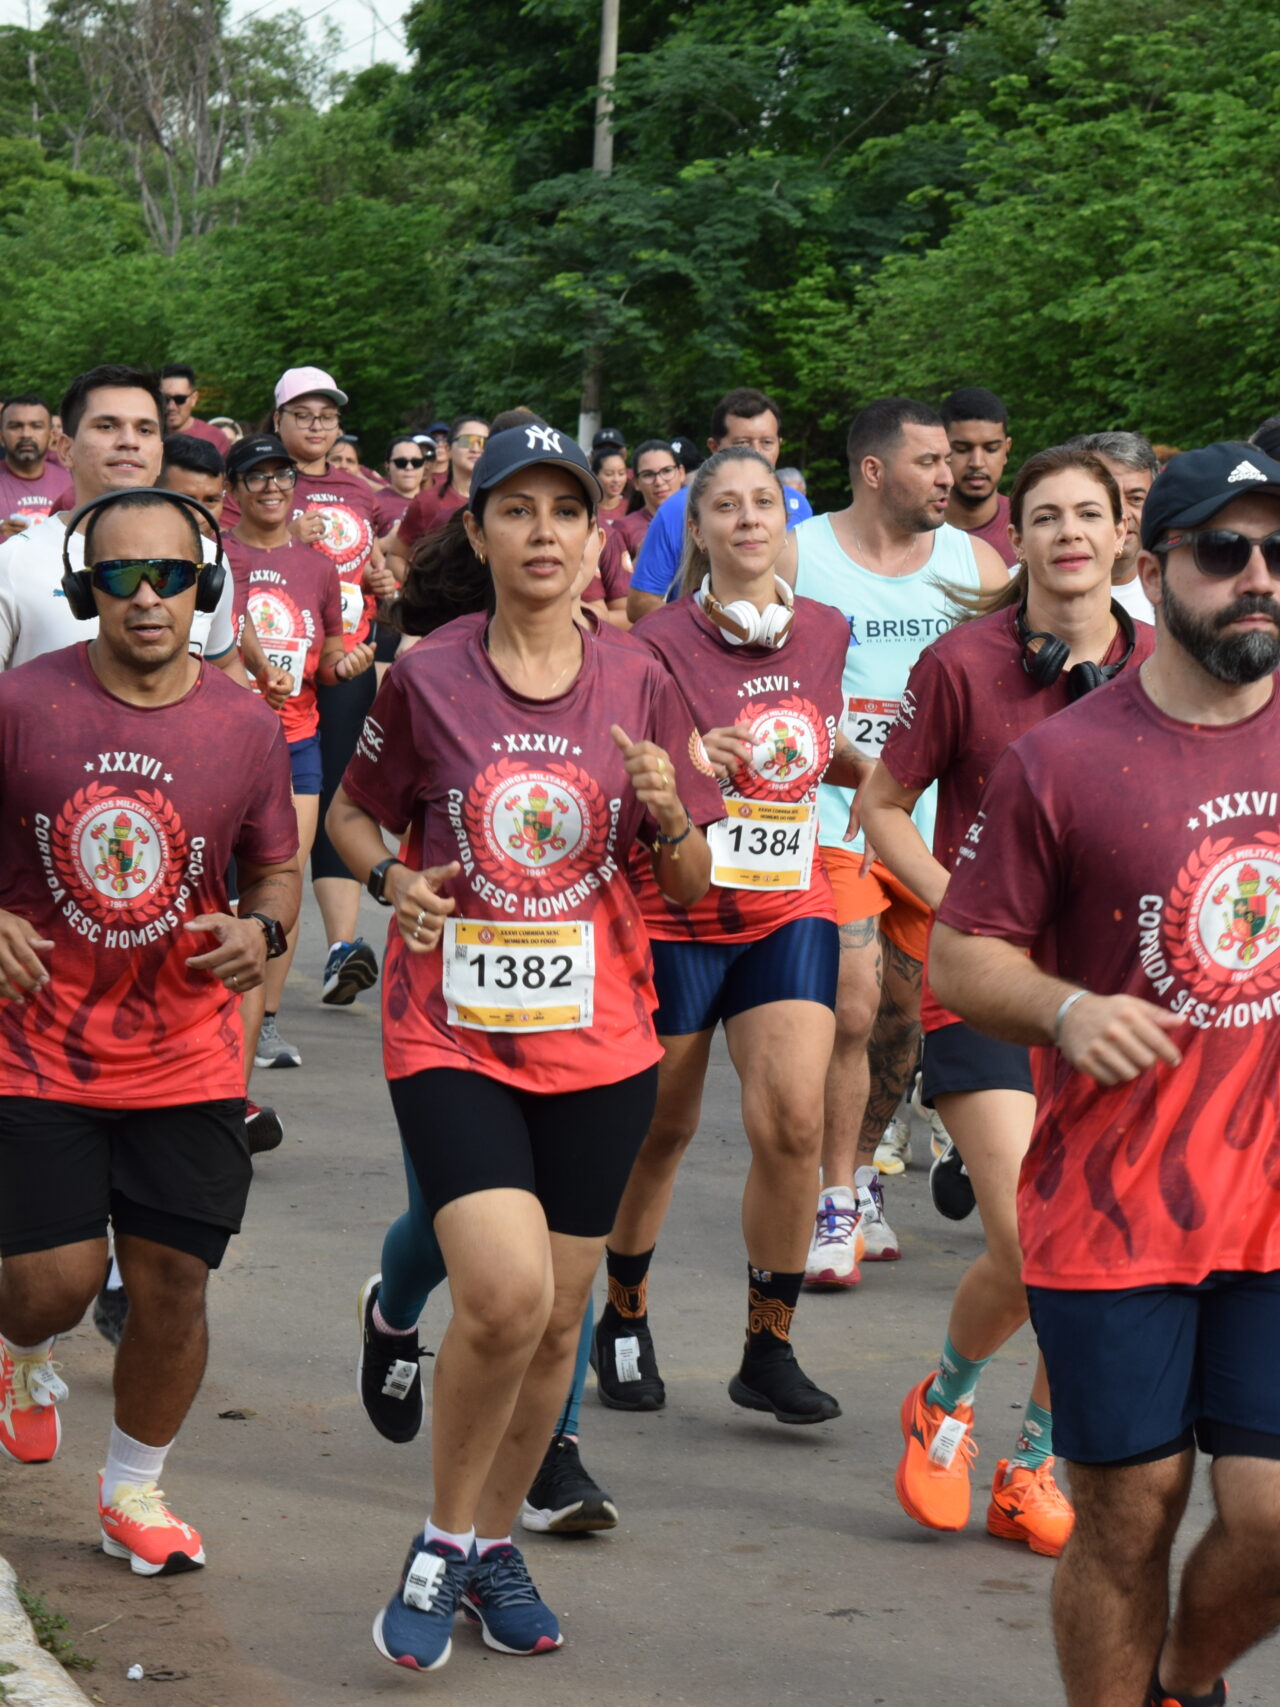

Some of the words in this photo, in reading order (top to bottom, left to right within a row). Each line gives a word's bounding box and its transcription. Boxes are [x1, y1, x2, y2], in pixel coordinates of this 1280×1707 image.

[525, 425, 563, 453] NY
[1227, 471, 1268, 483] adidas
[743, 676, 789, 697] XXXVI
[503, 734, 569, 756] XXXVI
[98, 751, 163, 780] XXXVI
[528, 774, 568, 789] MILITAR
[116, 800, 152, 818] MILITAR
[1198, 790, 1278, 828] XXXVI
[447, 788, 475, 878] CORRIDA
[470, 874, 518, 914] SESC
[523, 872, 601, 917] HOMENS
[728, 824, 801, 857] 1384
[1235, 848, 1280, 862] MILITAR
[34, 812, 66, 903] CORRIDA
[62, 900, 101, 943] SESC
[104, 910, 178, 949] HOMENS
[174, 884, 191, 912] DO
[1138, 894, 1175, 997] CORRIDA
[469, 953, 573, 989] 1382
